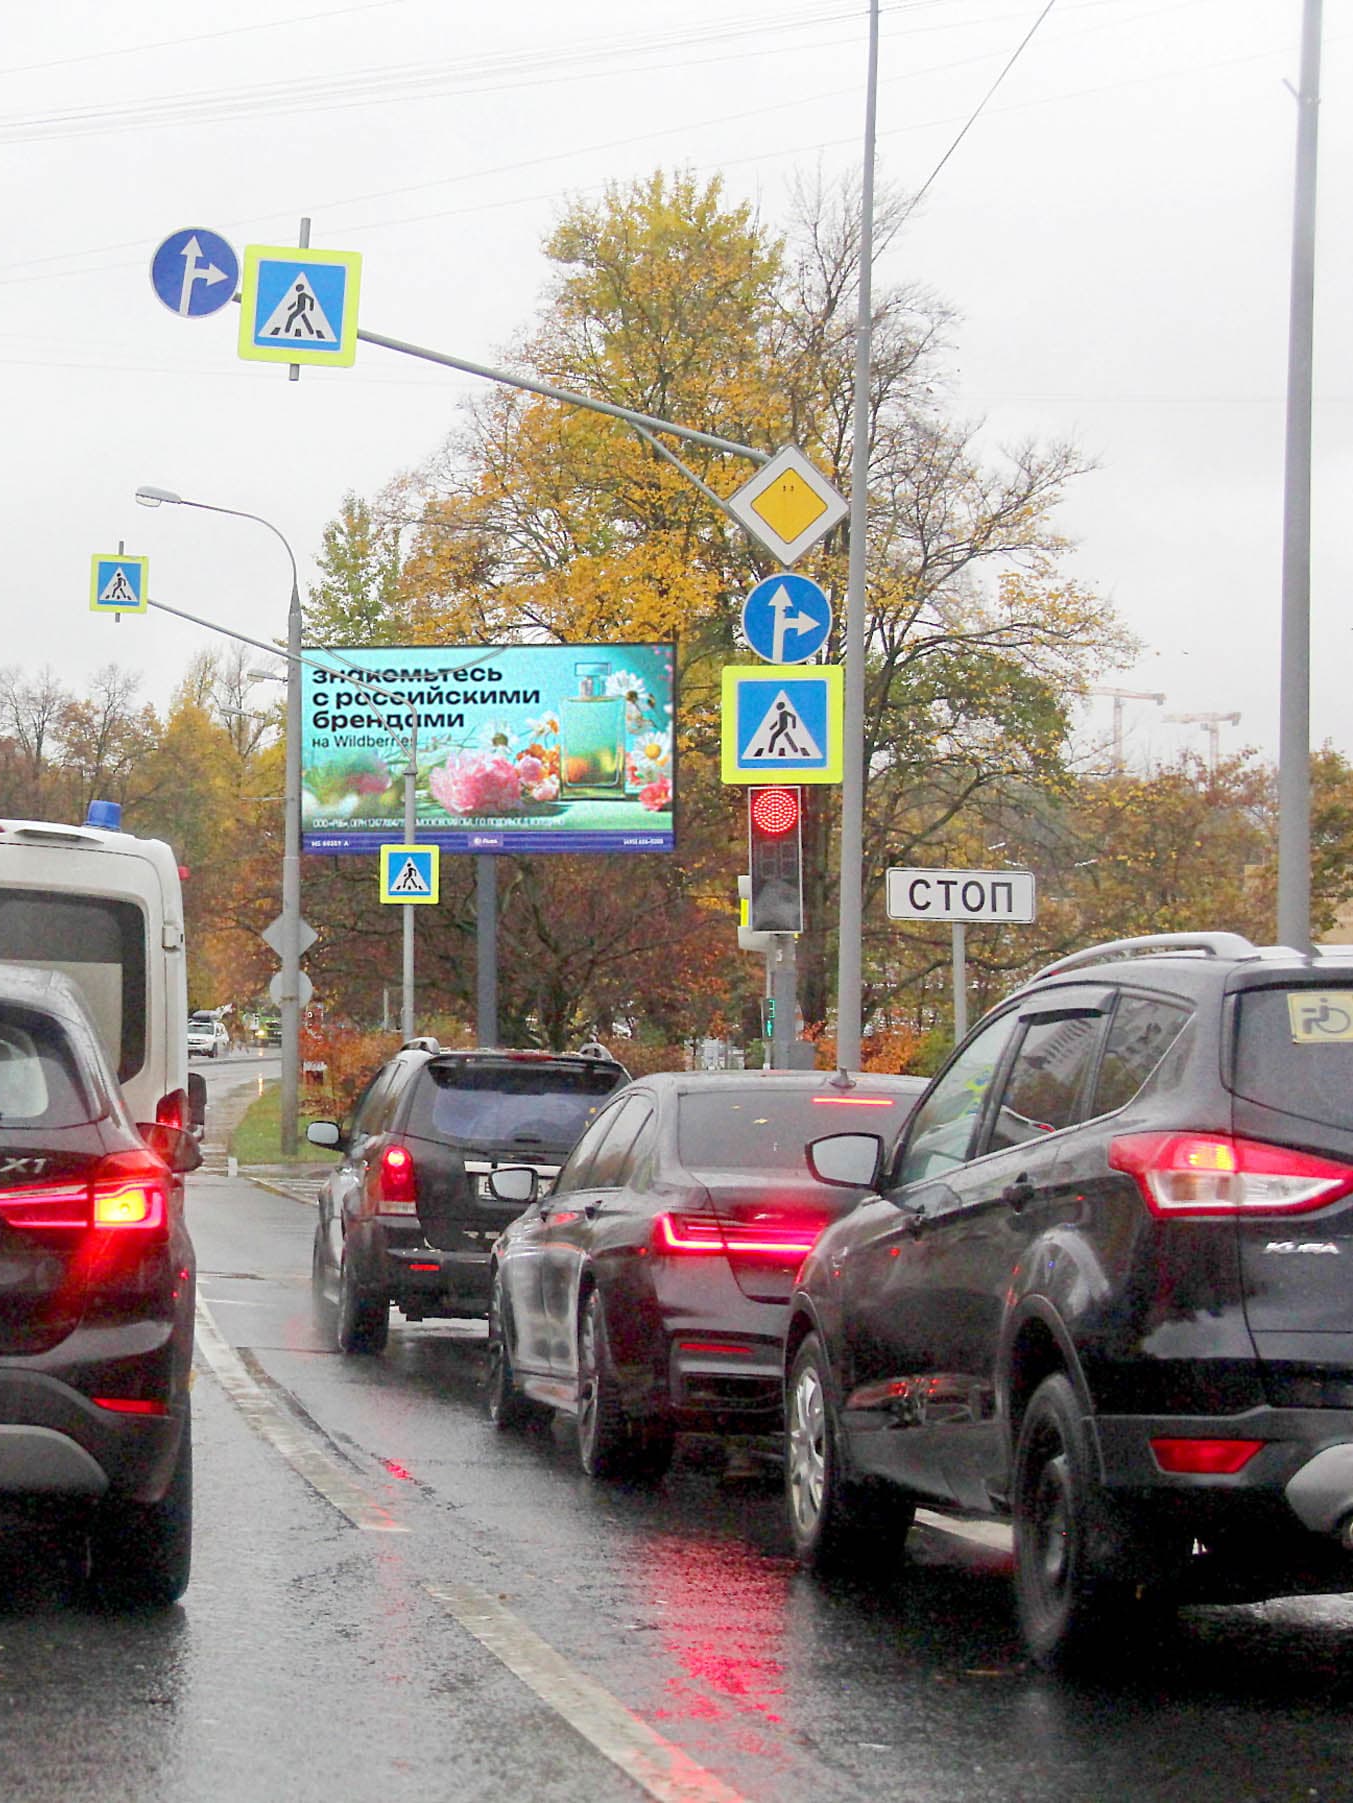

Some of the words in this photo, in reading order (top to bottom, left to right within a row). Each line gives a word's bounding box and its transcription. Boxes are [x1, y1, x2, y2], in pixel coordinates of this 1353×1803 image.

[312, 668, 502, 684] знакомьтесь
[312, 692, 329, 706] с
[336, 685, 540, 709] российскими
[312, 711, 464, 732] брендами
[312, 737, 329, 748] на
[909, 879, 1012, 912] СТОП
